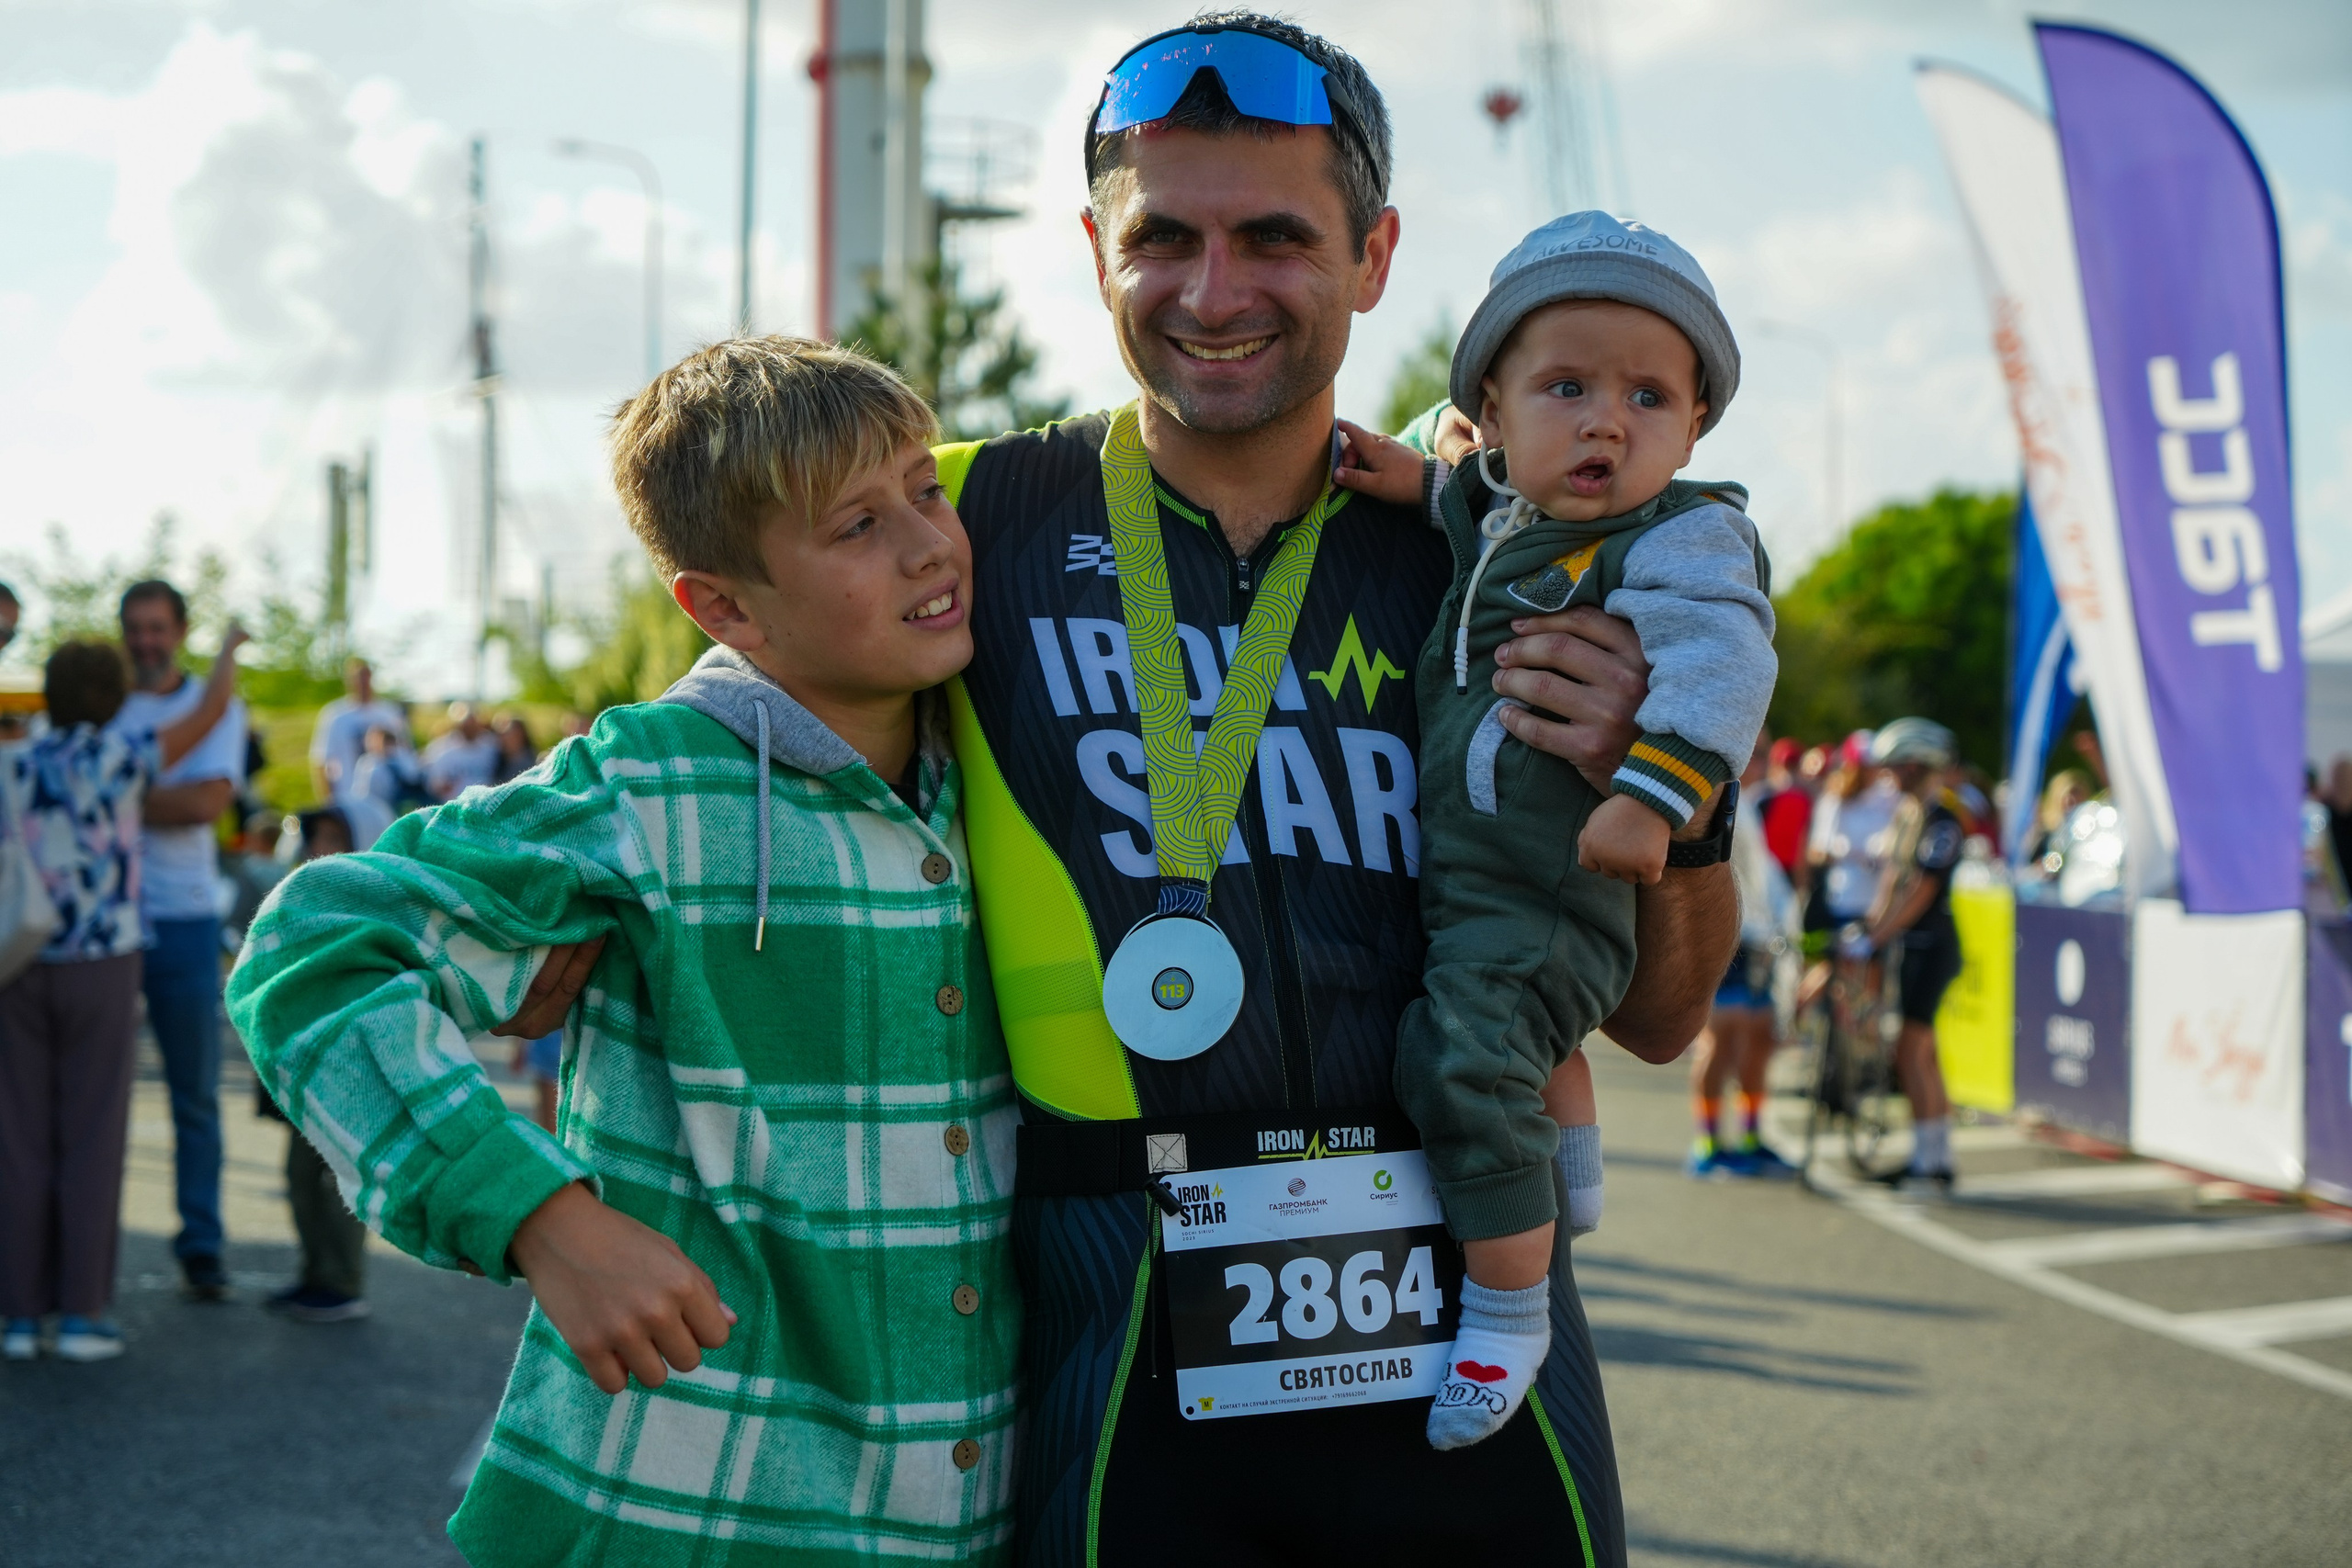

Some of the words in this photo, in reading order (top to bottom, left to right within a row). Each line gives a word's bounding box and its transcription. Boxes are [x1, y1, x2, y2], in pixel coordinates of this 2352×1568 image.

[1532, 233, 1658, 262] AWESOME
[1159, 983, 1185, 998] 113
[1257, 1129, 1305, 1152] IRON
[1328, 1126, 1375, 1148] STAR
[1177, 1184, 1210, 1203] IRON
[1369, 1191, 1398, 1201] Сириус
[1268, 1198, 1329, 1211] ГАЗПРОМБАНК
[1279, 1206, 1319, 1217] ПРЕМИУМ
[1179, 1201, 1227, 1228] STAR
[1224, 1246, 1443, 1347] 2864
[1279, 1357, 1413, 1392] СВЯТОСЛАВ
[1269, 1396, 1301, 1405] ЭКСТРЕННОЙ
